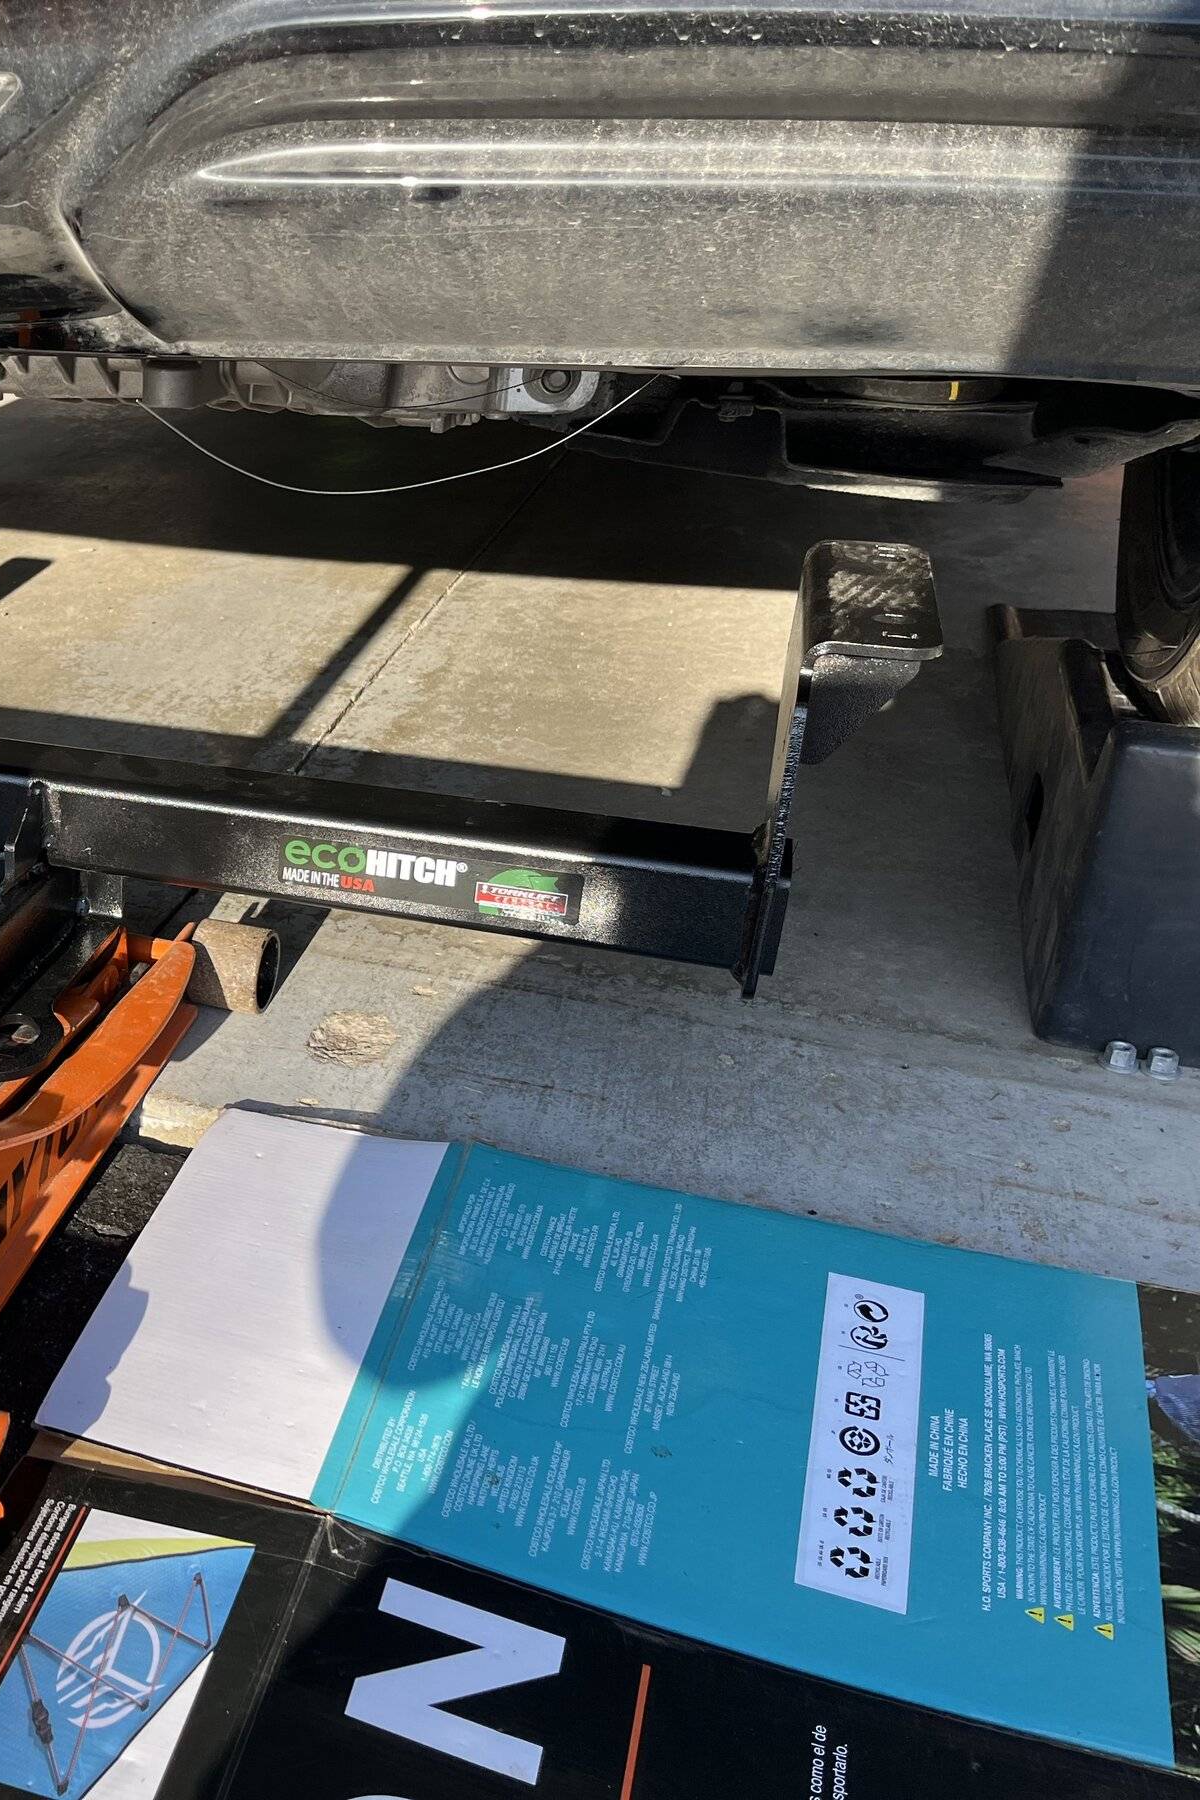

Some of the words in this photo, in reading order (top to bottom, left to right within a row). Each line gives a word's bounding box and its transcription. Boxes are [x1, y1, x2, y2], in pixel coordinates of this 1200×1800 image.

[282, 867, 311, 884] MADE
[311, 872, 322, 886] IN
[322, 873, 340, 888] THE
[340, 875, 375, 893] USA
[929, 1413, 940, 1440] CHINA
[943, 1407, 954, 1434] CHINE
[957, 1415, 968, 1443] CHINA
[982, 1417, 993, 1442] PLACE
[927, 1450, 939, 1478] MADE
[942, 1446, 953, 1492] FABRIQUÉ
[957, 1456, 968, 1489] HECHO
[982, 1441, 993, 1479] BRACKEN
[43, 1500, 65, 1531] Cordons
[56, 1503, 76, 1531] Bungee
[41, 1531, 60, 1560] storage
[981, 1518, 992, 1560] COMPANY
[14, 1569, 27, 1588] pour
[980, 1559, 992, 1594] SPORTS
[13, 1593, 28, 1613] stern
[980, 1591, 992, 1612] H.O.
[812, 1725, 827, 1742] de
[811, 1742, 826, 1756] el
[810, 1758, 825, 1794] como
